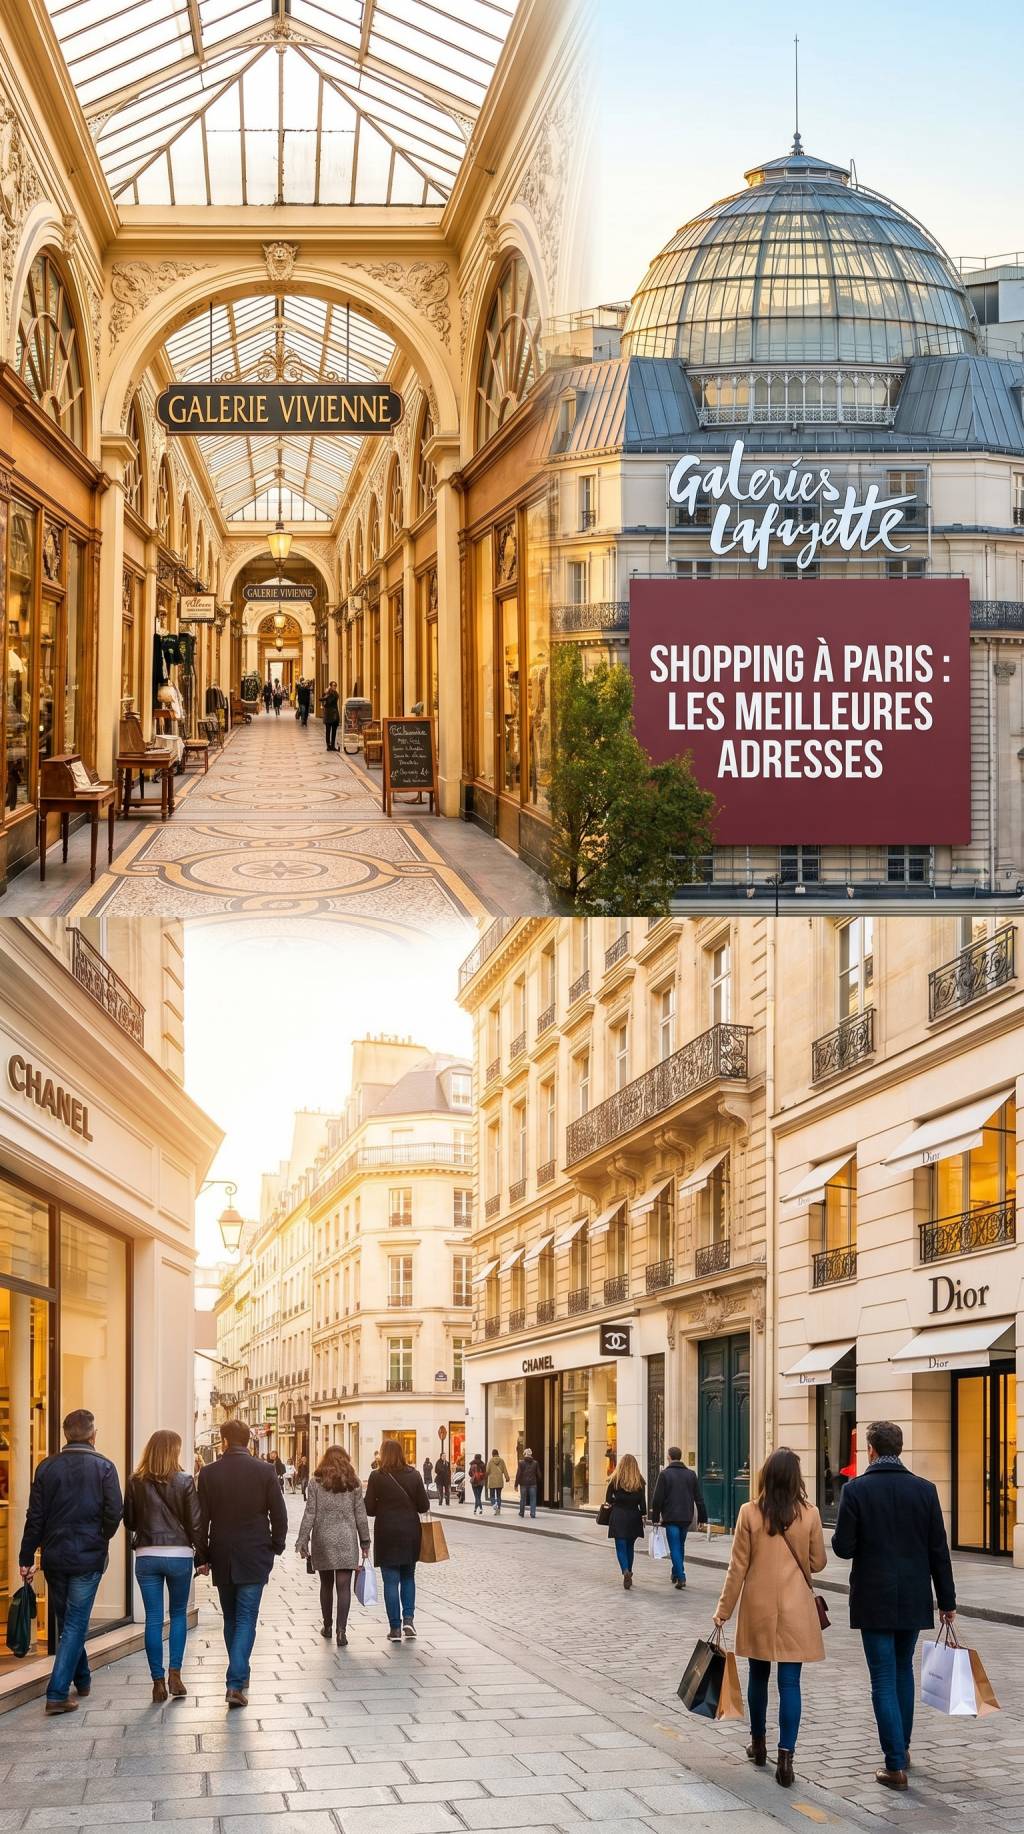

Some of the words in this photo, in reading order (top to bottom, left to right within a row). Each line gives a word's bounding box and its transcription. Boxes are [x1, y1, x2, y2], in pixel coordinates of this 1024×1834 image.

[168, 395, 269, 423] GALERIE
[279, 395, 391, 423] VIVIENNE
[710, 485, 917, 570] Lafayette
[247, 588, 278, 598] GALERIE
[279, 588, 313, 598] VIVIENNE
[650, 644, 804, 683] SHOPPING
[813, 637, 834, 683] À
[844, 644, 933, 683] PARIS
[668, 691, 725, 731] LES
[735, 691, 933, 731] MEILLEURES
[717, 739, 883, 779] ADRESSES
[8, 1054, 93, 1142] CHANEL
[928, 1276, 990, 1315] Dior
[522, 1355, 554, 1373] CHANEL
[928, 1356, 949, 1369] Dior
